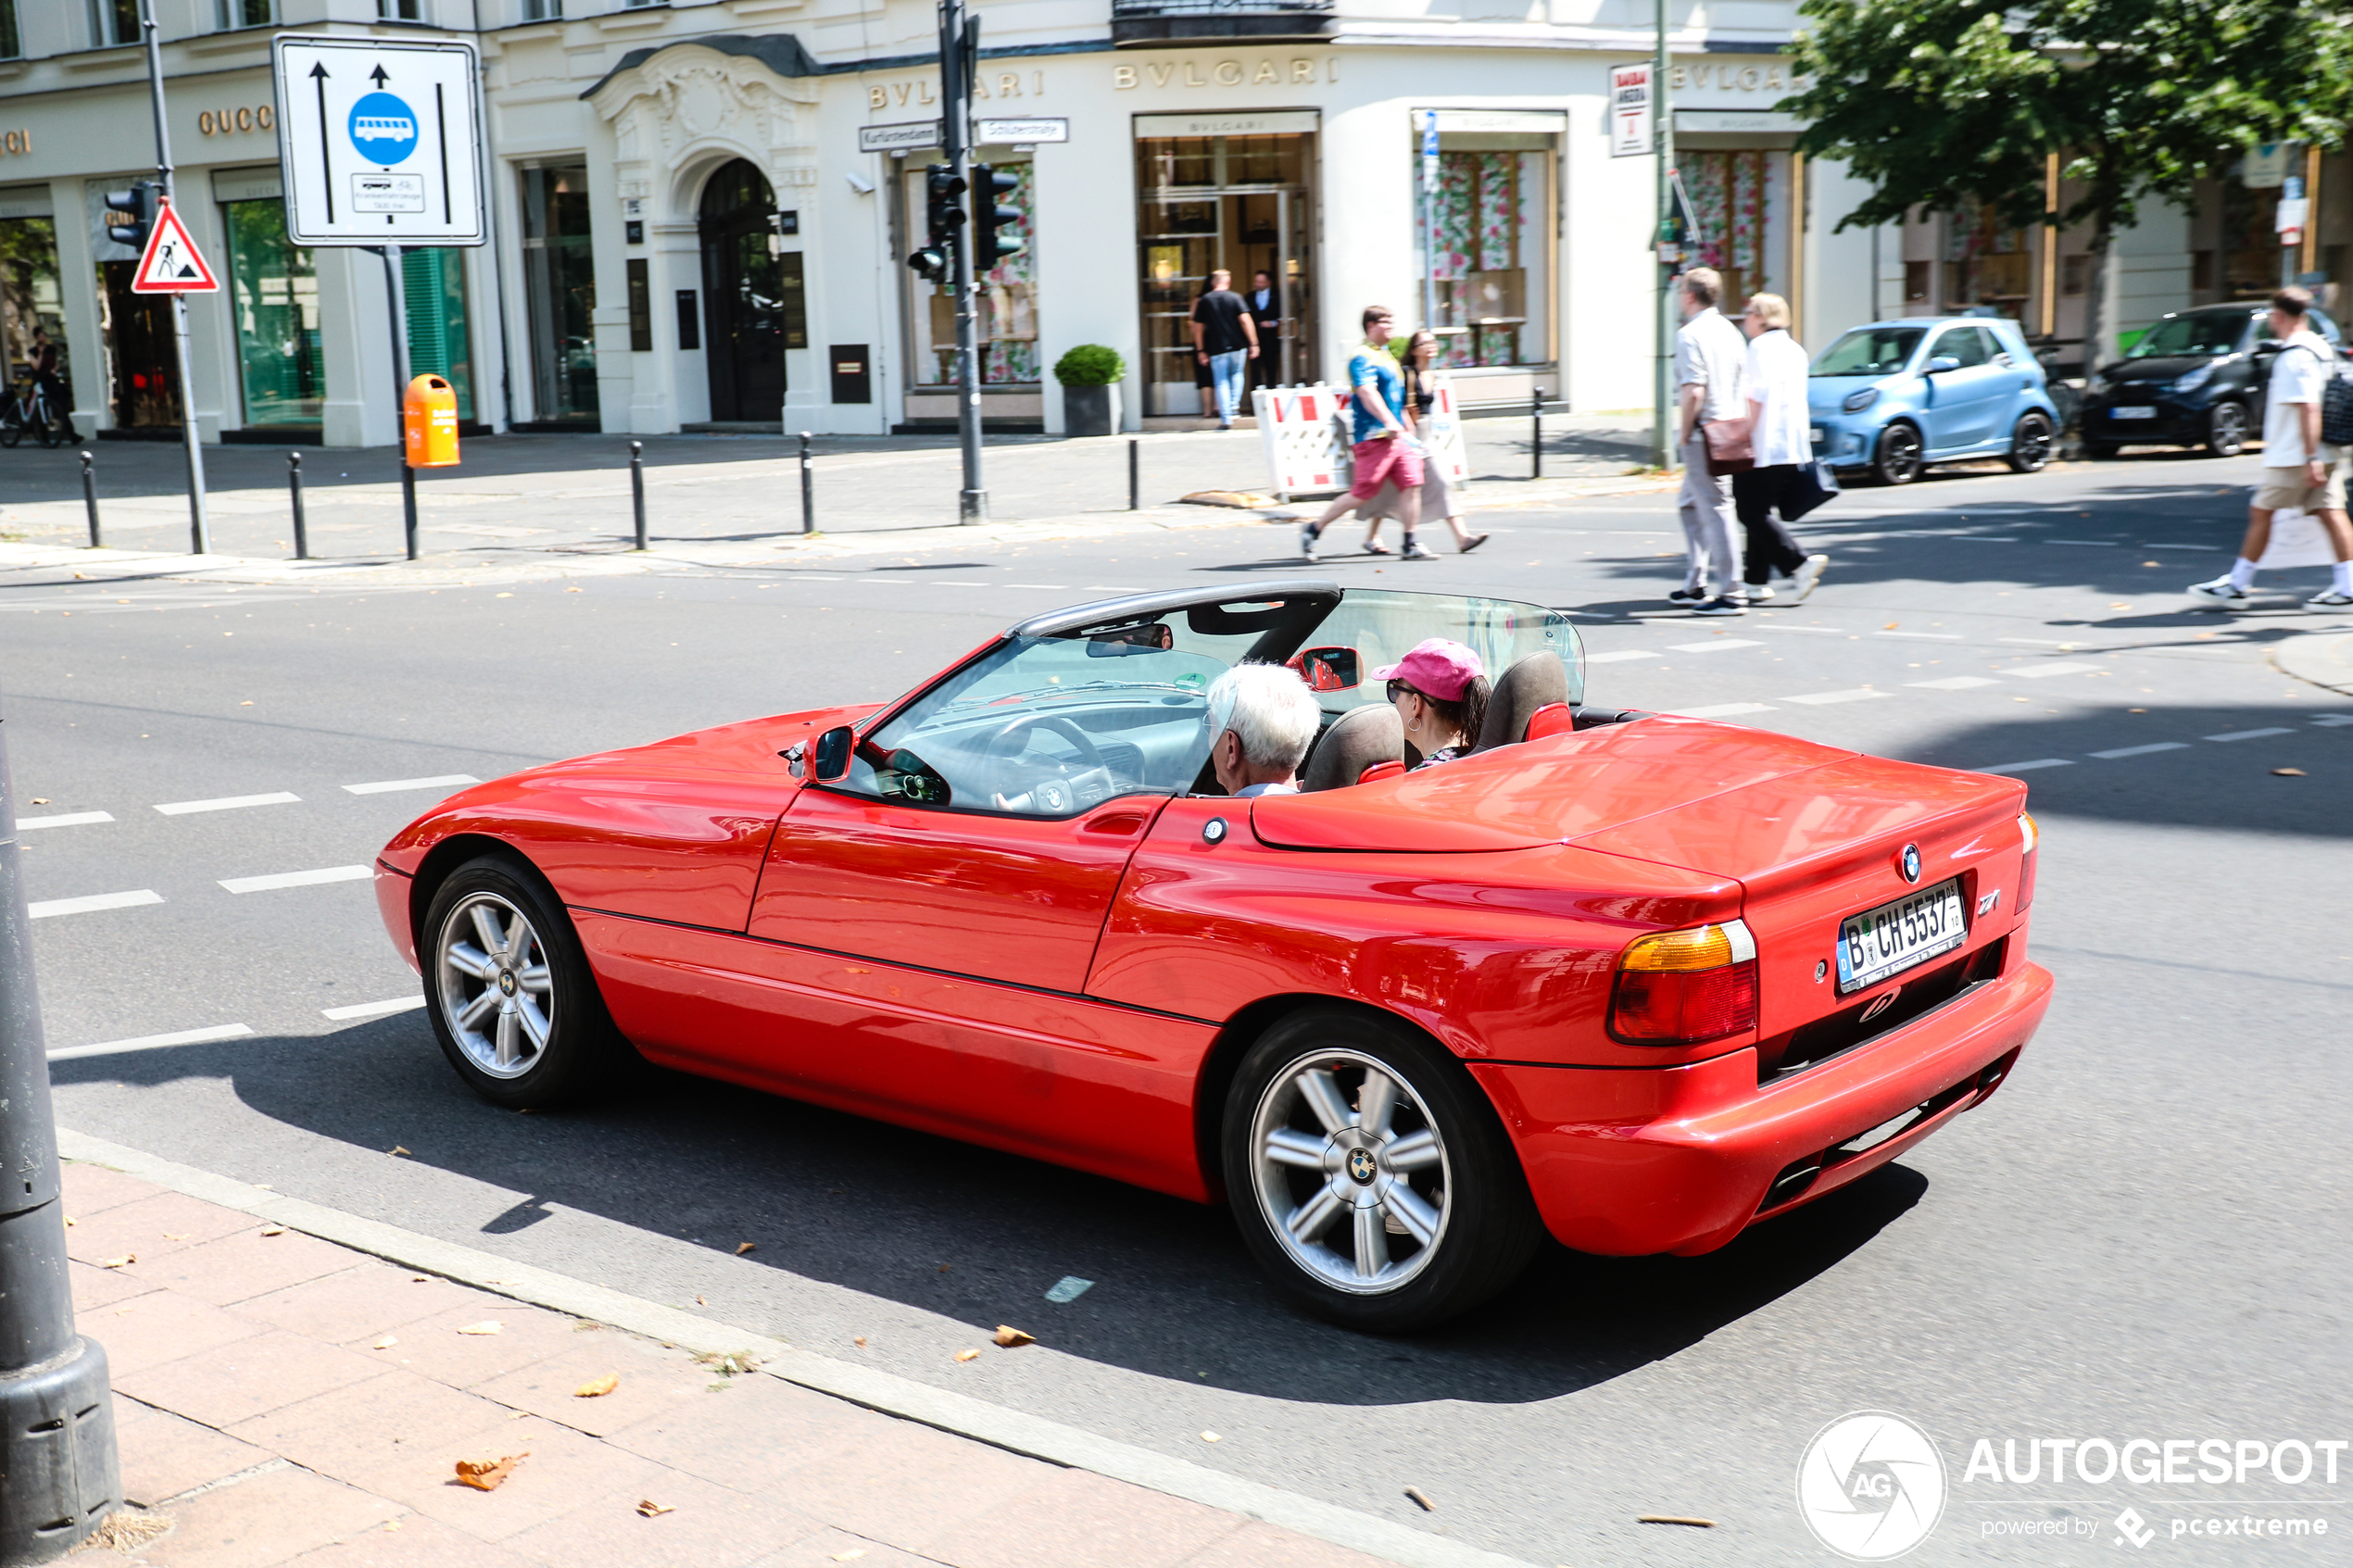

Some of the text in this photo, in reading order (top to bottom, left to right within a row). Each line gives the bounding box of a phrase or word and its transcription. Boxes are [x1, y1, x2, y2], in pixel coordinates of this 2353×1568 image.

[1114, 58, 1340, 90] BVLGARI
[1671, 65, 1808, 91] BVLGAR
[870, 70, 1044, 109] BVLARI
[199, 106, 275, 136] GUCC
[1189, 120, 1265, 132] BVLGARI
[1946, 885, 1955, 897] 05
[1978, 889, 2001, 915] Z1
[1846, 924, 1864, 972] B
[1875, 908, 1904, 958] CH
[1903, 888, 1945, 947] 5537
[1841, 959, 1848, 972] D
